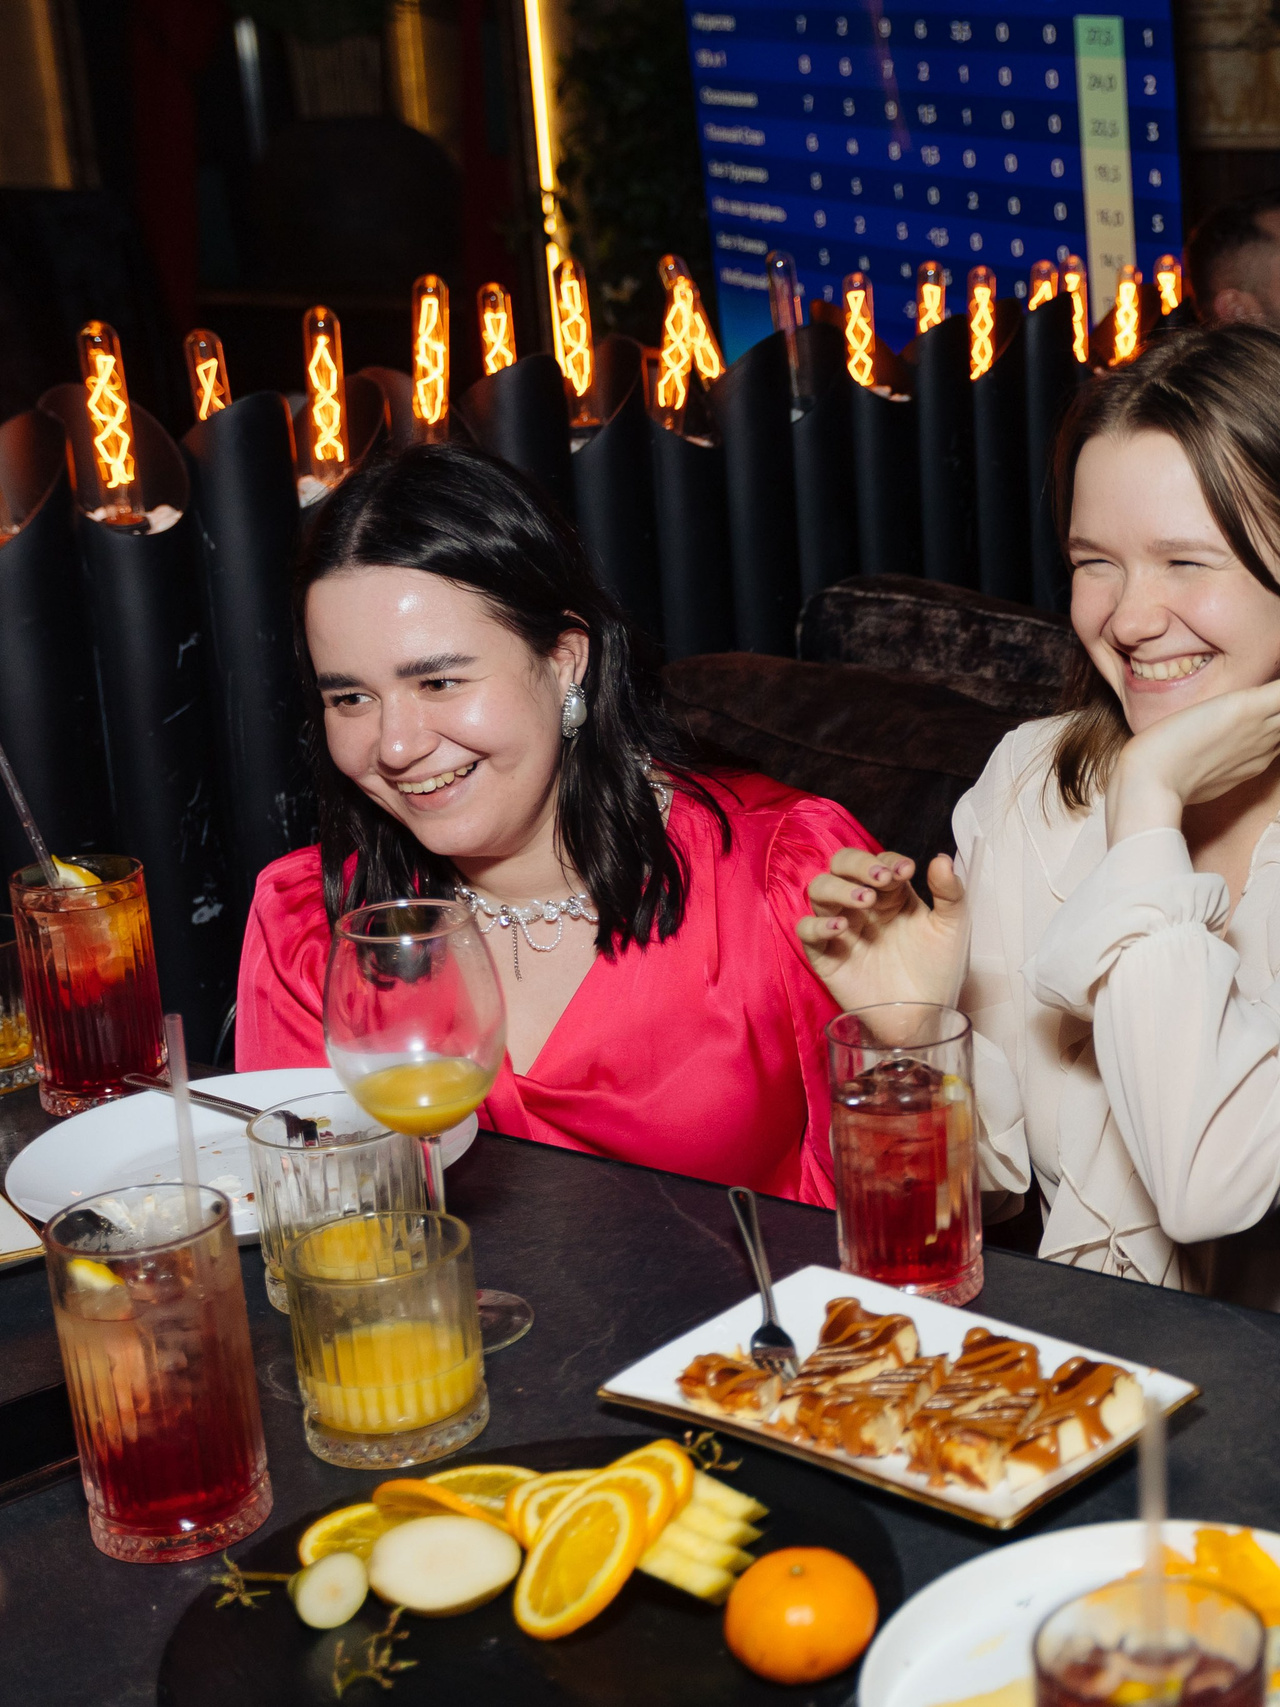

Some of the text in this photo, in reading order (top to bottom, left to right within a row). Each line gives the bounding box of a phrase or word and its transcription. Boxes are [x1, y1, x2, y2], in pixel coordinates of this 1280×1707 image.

[996, 22, 1009, 42] 0
[1043, 24, 1056, 44] 0
[1143, 28, 1153, 47] 1
[917, 61, 929, 81] 2
[998, 66, 1012, 86] 0
[1045, 69, 1059, 89] 0
[1144, 74, 1157, 95] 2
[1001, 110, 1015, 129] 0
[1048, 114, 1061, 133] 0
[1147, 122, 1159, 141] 3
[963, 149, 976, 168] 0
[1004, 153, 1018, 173] 0
[1051, 158, 1064, 178] 0
[1149, 169, 1162, 188] 4
[927, 186, 940, 205] 0
[967, 191, 979, 210] 2
[1008, 196, 1021, 215] 0
[1054, 202, 1067, 221] 0
[1152, 214, 1164, 233] 5
[970, 233, 983, 251] 0
[1011, 238, 1024, 257] 0
